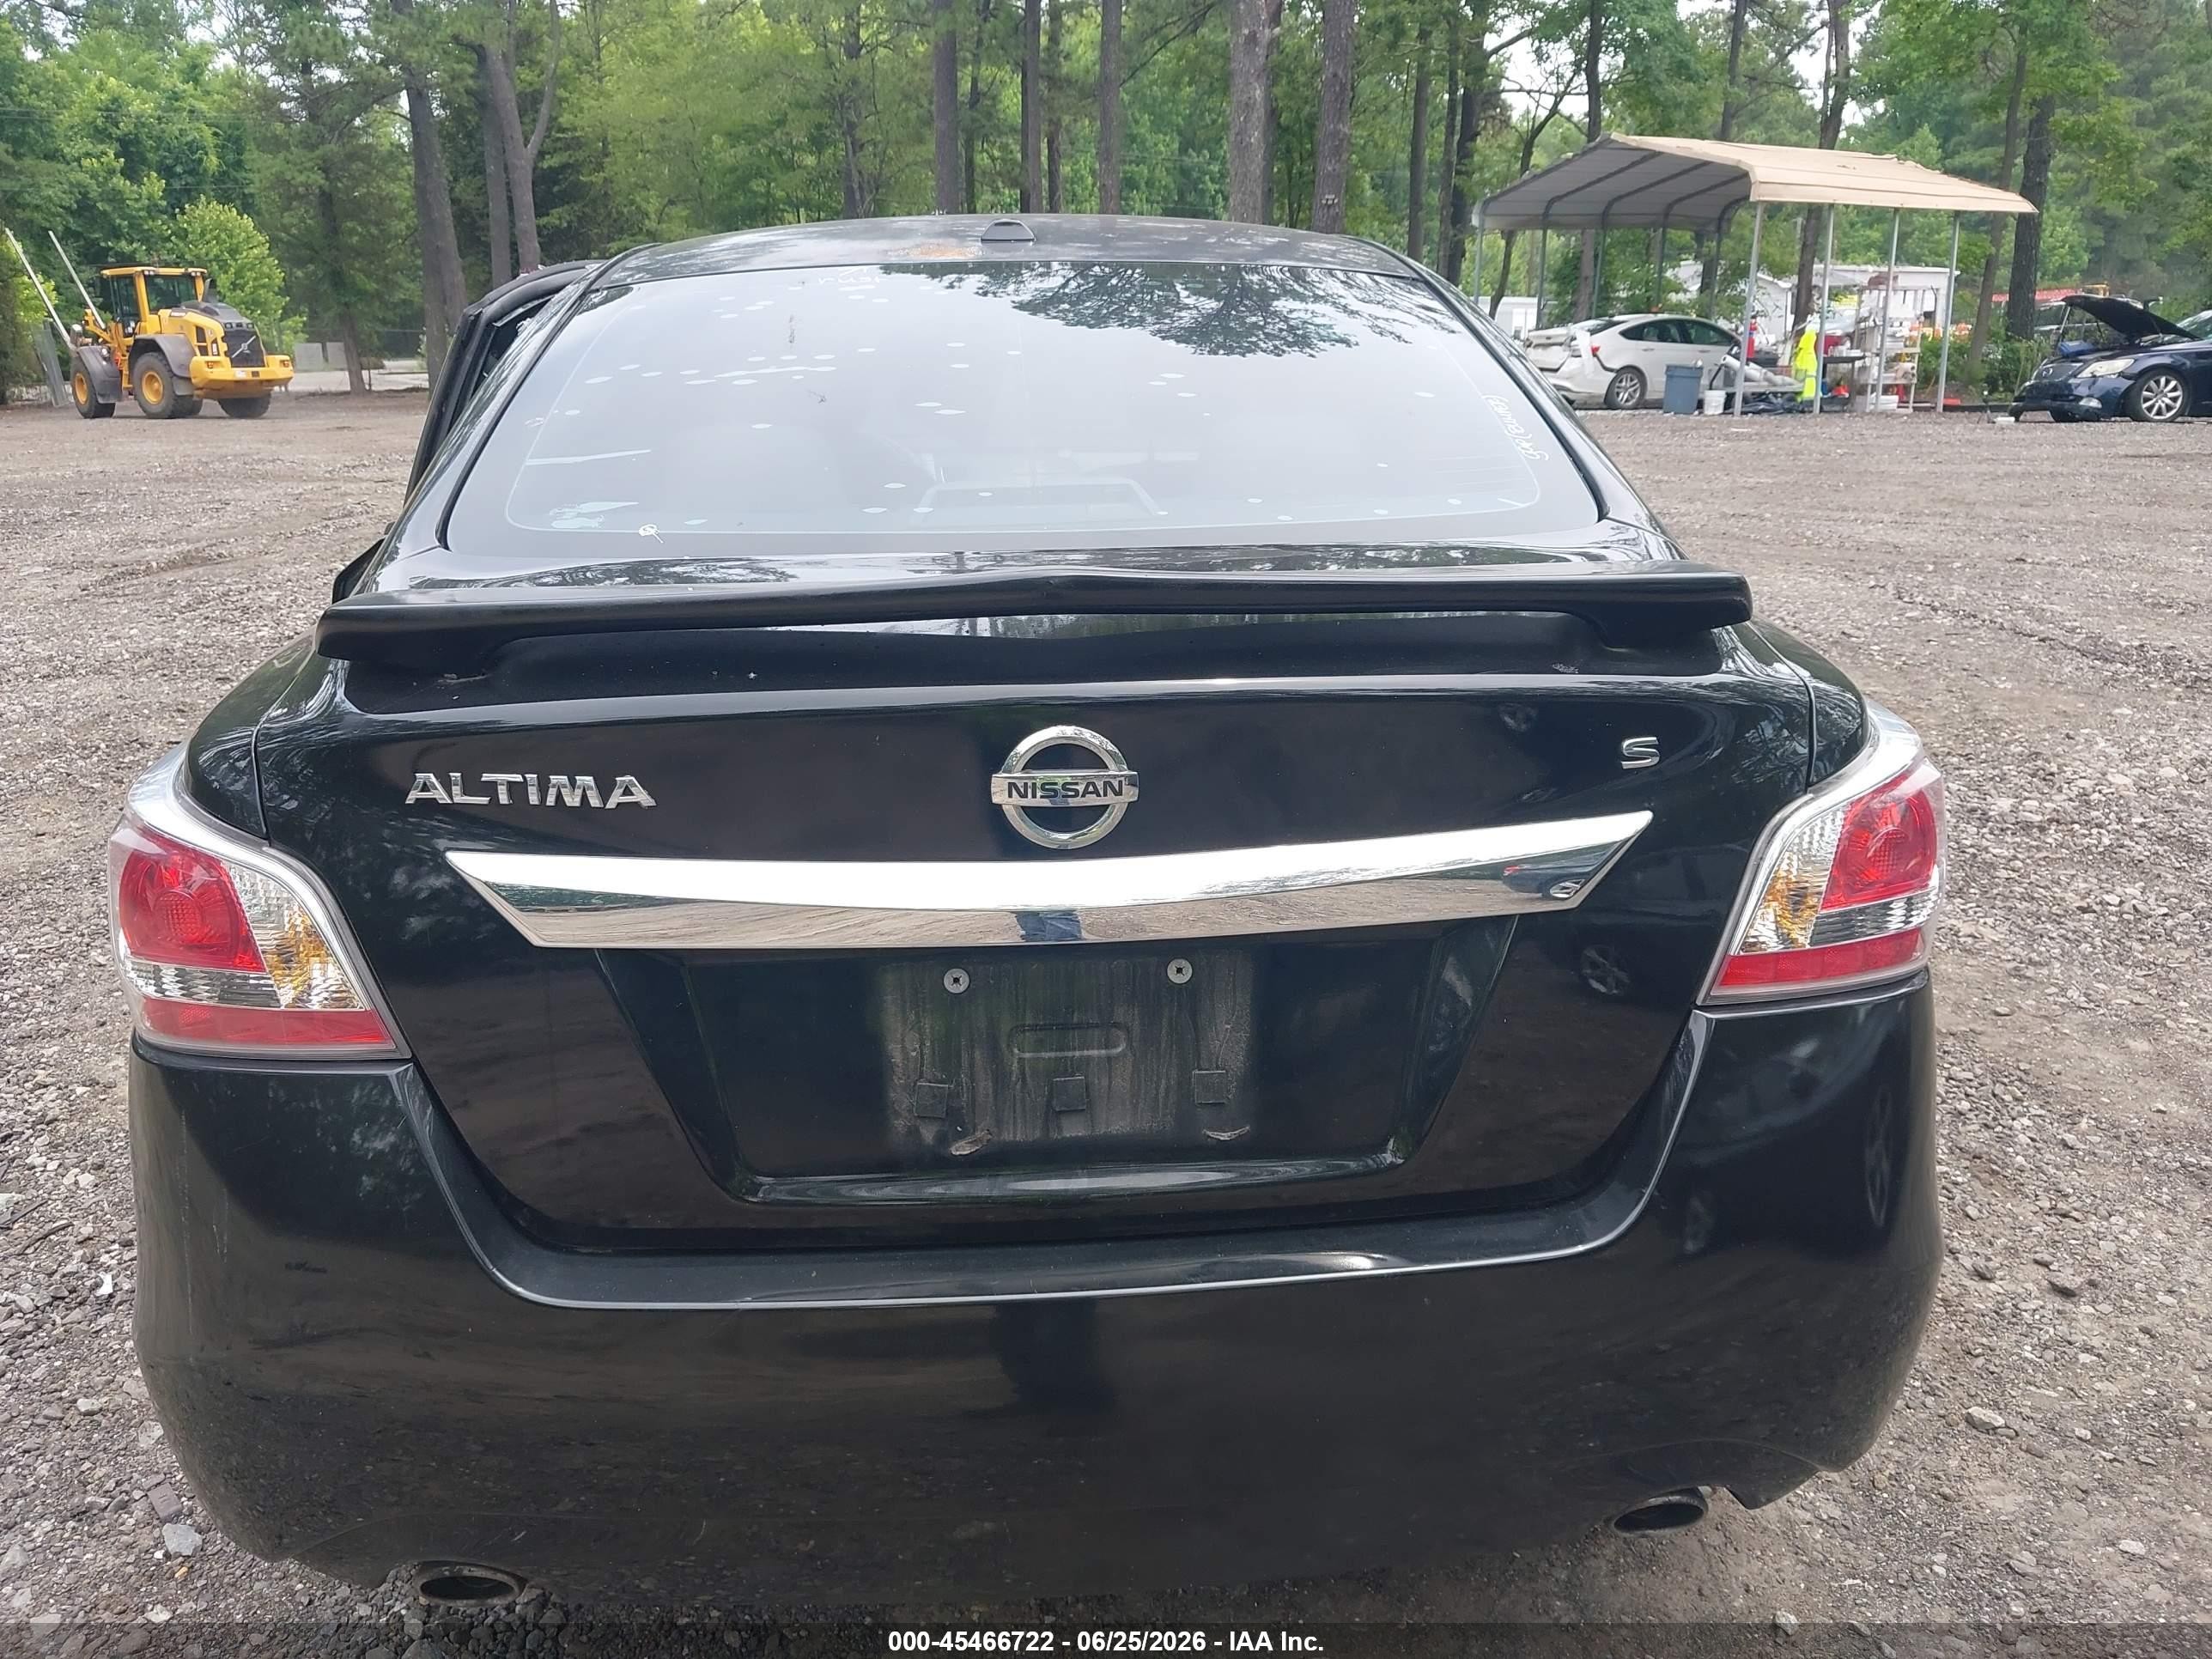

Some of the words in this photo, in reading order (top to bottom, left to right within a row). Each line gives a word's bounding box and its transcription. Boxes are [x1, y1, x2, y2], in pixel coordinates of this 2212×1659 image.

[1621, 737, 1661, 769] S
[404, 772, 658, 810] ALTIMA
[1007, 780, 1123, 799] NISSAN
